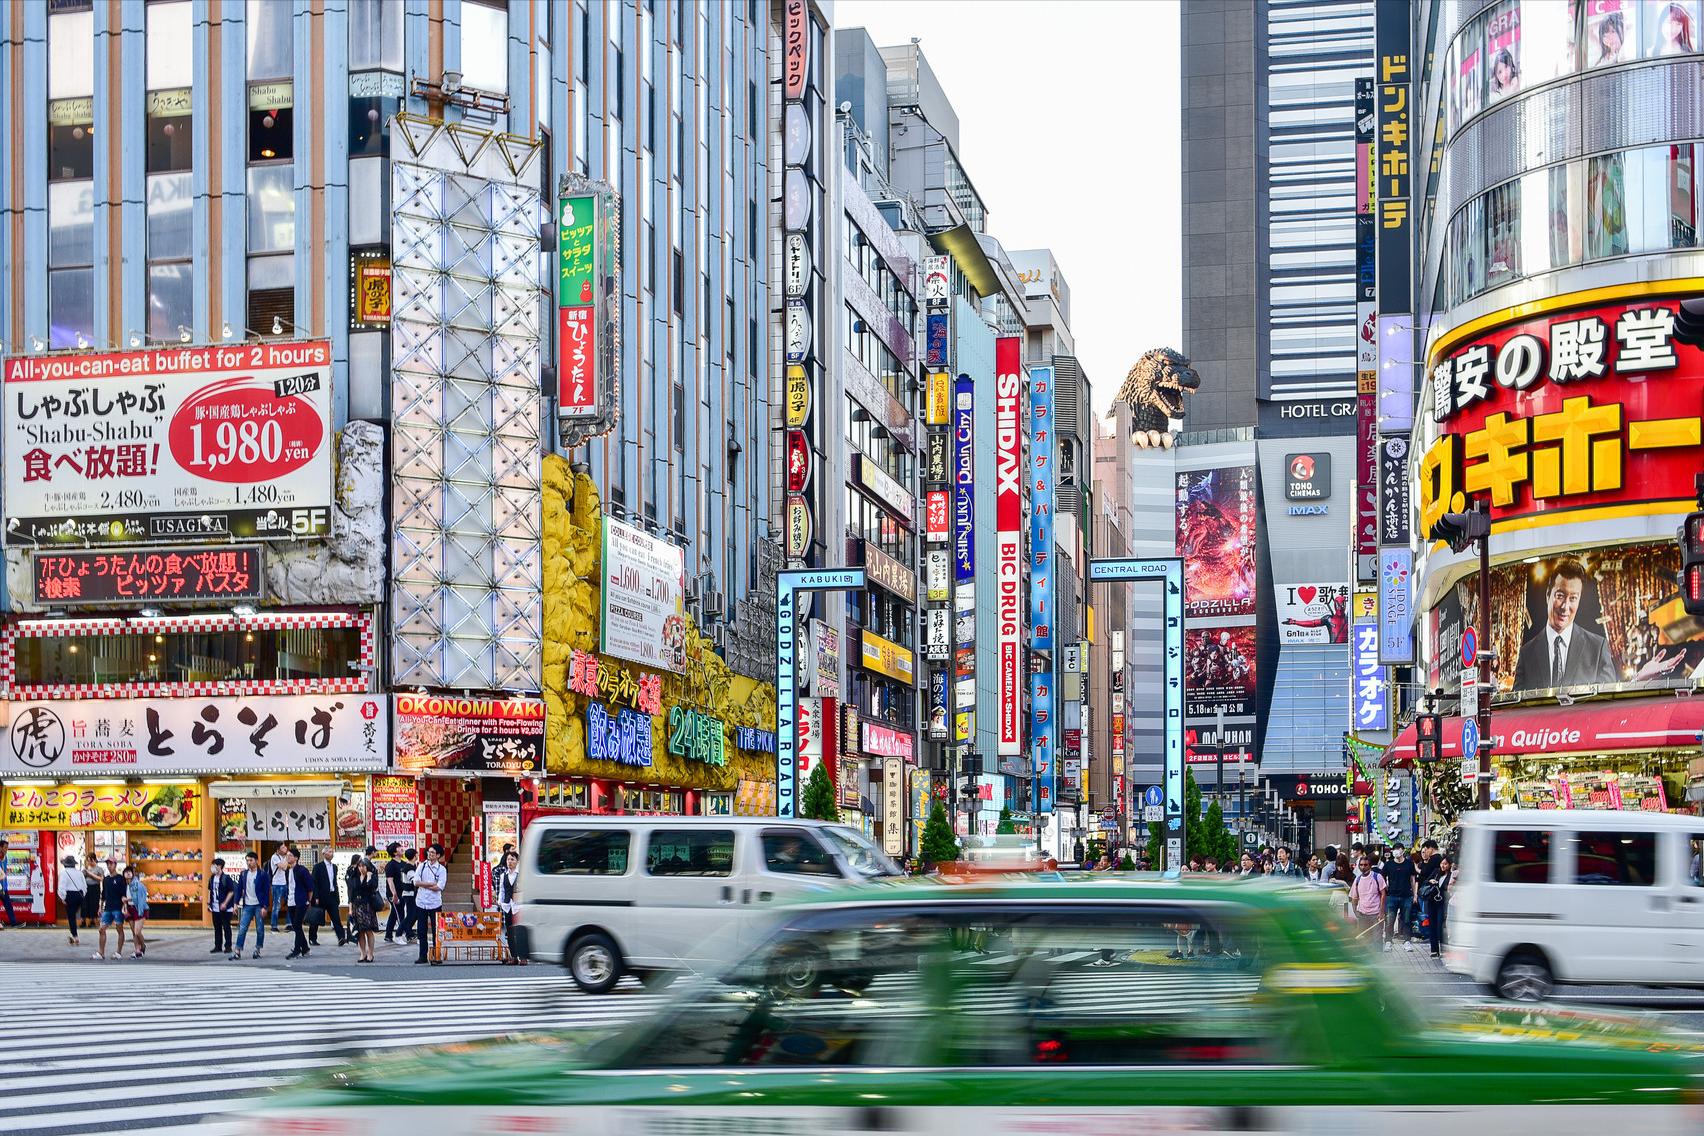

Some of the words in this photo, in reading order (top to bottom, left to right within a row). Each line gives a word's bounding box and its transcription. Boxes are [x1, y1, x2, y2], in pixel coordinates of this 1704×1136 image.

[251, 85, 277, 95] Shabu
[265, 94, 291, 104] Shabu
[562, 245, 591, 260] サラダ
[573, 239, 581, 247] と
[562, 263, 593, 278] スイーツ
[573, 257, 581, 265] と
[568, 310, 587, 321] 新宿
[11, 353, 151, 379] All-you-can-eat
[156, 349, 211, 371] buffet
[216, 348, 245, 368] for
[250, 347, 263, 366] 2
[269, 345, 326, 365] hours
[567, 320, 589, 404] ひょうたん
[1433, 308, 1678, 423] 驚安の殿堂
[278, 376, 317, 398] 120分
[17, 383, 166, 420] しゃぶしゃぶ
[571, 406, 585, 415] 7F
[1281, 403, 1328, 418] HOTEL
[789, 416, 801, 424] 4F
[189, 419, 284, 472] 1,980
[285, 447, 310, 462] yen
[23, 442, 161, 484] 食べ放題!
[234, 485, 278, 506] 1,480
[278, 492, 296, 505] yen
[1289, 489, 1321, 497] CINEMAS
[1290, 482, 1313, 490] TOHO
[101, 488, 144, 510] 2,480
[143, 496, 161, 509] yen
[1287, 504, 1329, 516] IMAX
[291, 509, 327, 534] 5F
[1001, 543, 1016, 576] BIC
[1094, 565, 1138, 574] CENTRAL
[1141, 564, 1167, 573] ROAD
[45, 578, 81, 598] 検索
[196, 572, 249, 592] パスタ
[932, 589, 944, 598] 3F
[1001, 580, 1016, 635] DRUG
[1387, 588, 1396, 624] STAGE
[1397, 588, 1406, 619] IDOL
[1005, 644, 1013, 661] BIC
[779, 610, 792, 728] GODZILLA
[1359, 627, 1386, 725] カラオケ
[933, 673, 945, 704] 海の家
[398, 699, 494, 717] OKONOMI
[499, 701, 545, 718] YAKI
[146, 702, 345, 758] とらそば
[457, 726, 480, 734] Drinks
[481, 726, 491, 734] for
[499, 727, 520, 735] hours
[458, 717, 481, 726] dinner
[482, 718, 497, 726] with
[499, 718, 544, 728] Free-Flowing
[17, 707, 58, 760] 虎
[1202, 730, 1252, 745] MAUHAN
[1464, 728, 1472, 754] P
[1511, 727, 1581, 751] Quijote
[76, 740, 103, 749] TORA
[107, 740, 134, 749] SOBA
[485, 761, 522, 770] TORADYU
[779, 741, 792, 797] ROAD
[10, 789, 149, 808] とんこつラーメン
[1310, 784, 1338, 794] TOHO
[1387, 778, 1402, 840] カラオケ
[250, 810, 328, 832] とらそば
